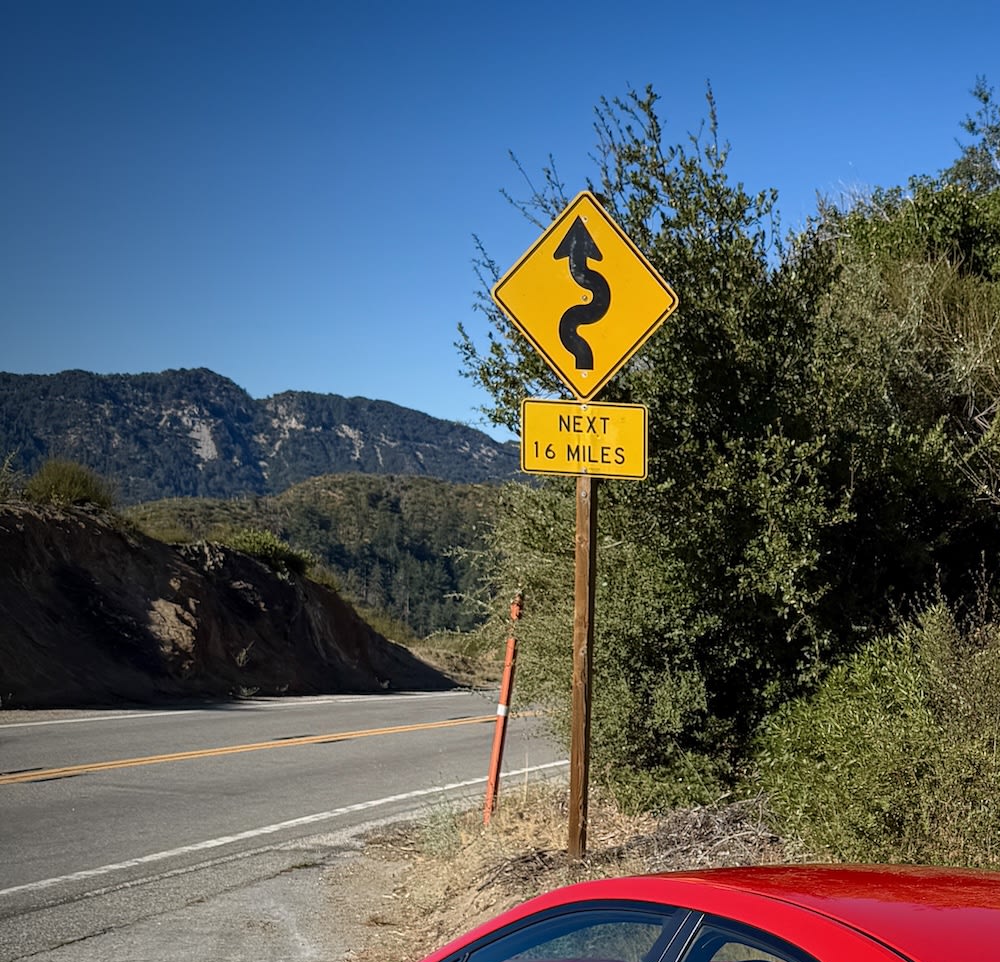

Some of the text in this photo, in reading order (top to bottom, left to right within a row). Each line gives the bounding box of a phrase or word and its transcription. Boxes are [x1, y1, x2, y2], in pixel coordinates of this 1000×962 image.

[559, 415, 610, 434] NEXT
[534, 441, 625, 465] 16 MILES
